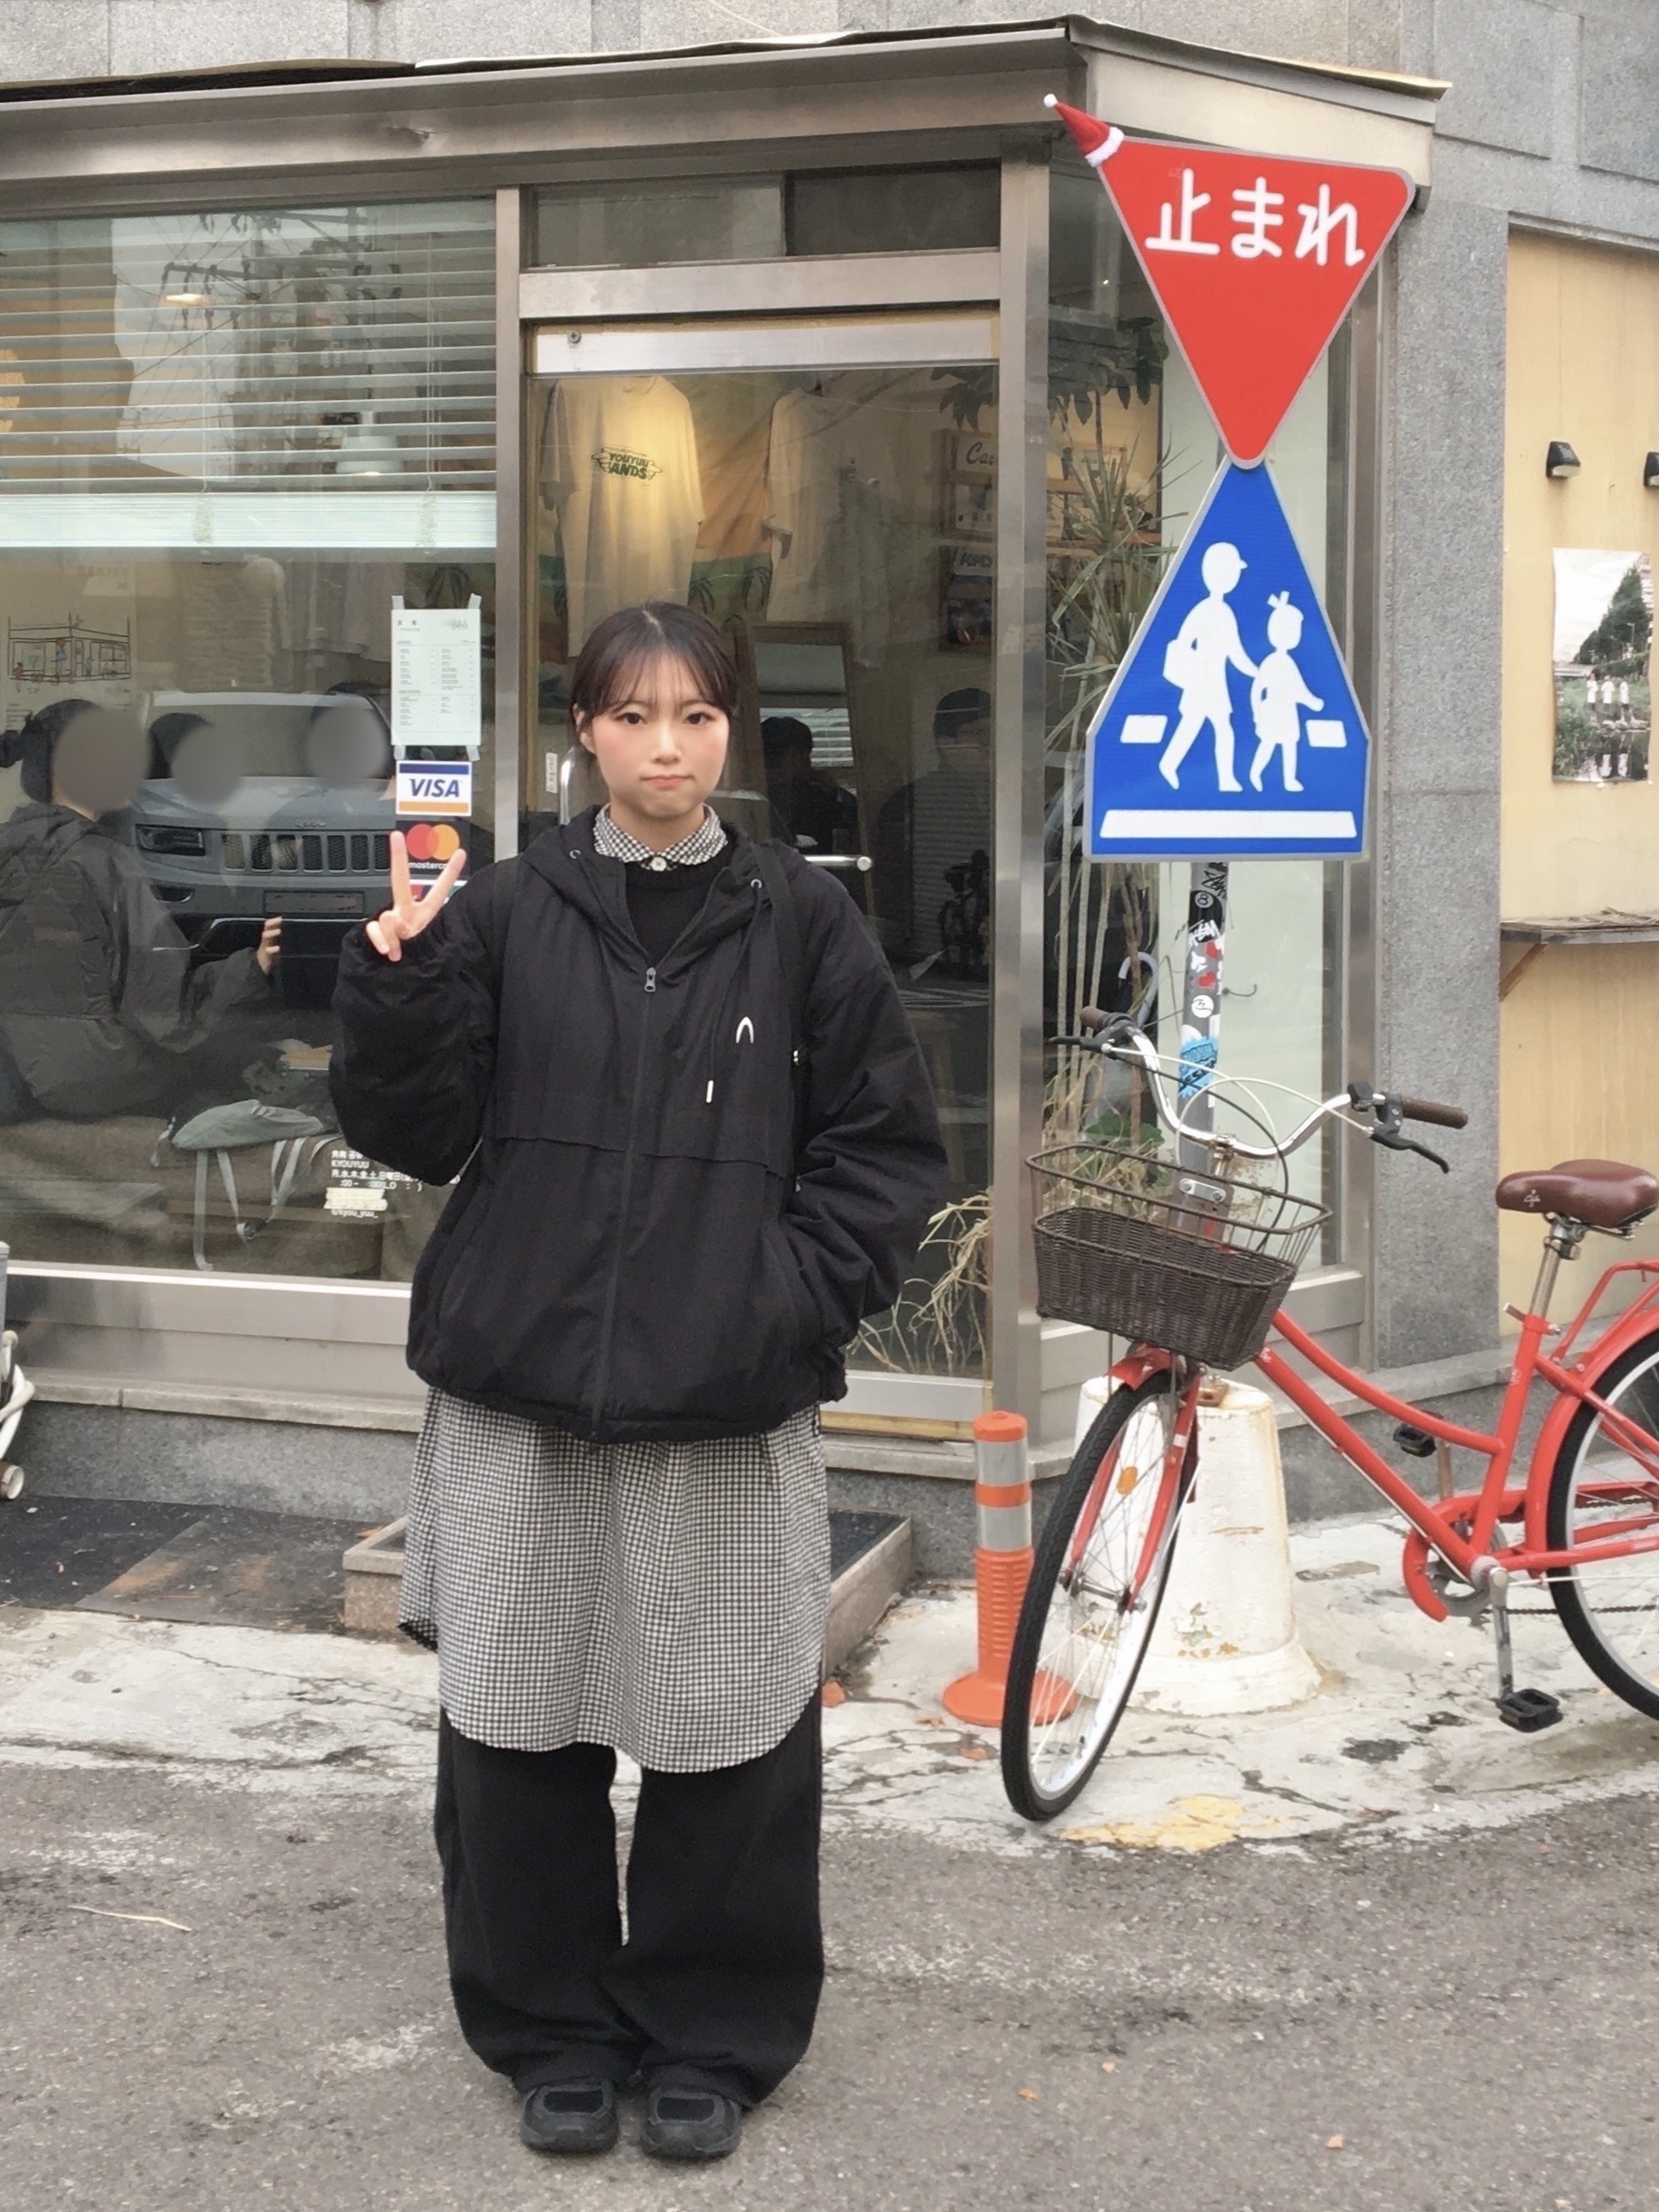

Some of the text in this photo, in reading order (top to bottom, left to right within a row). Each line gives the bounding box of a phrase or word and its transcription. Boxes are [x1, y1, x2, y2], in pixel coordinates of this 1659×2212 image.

[1144, 168, 1366, 267] 止まれ
[409, 778, 460, 797] VISA
